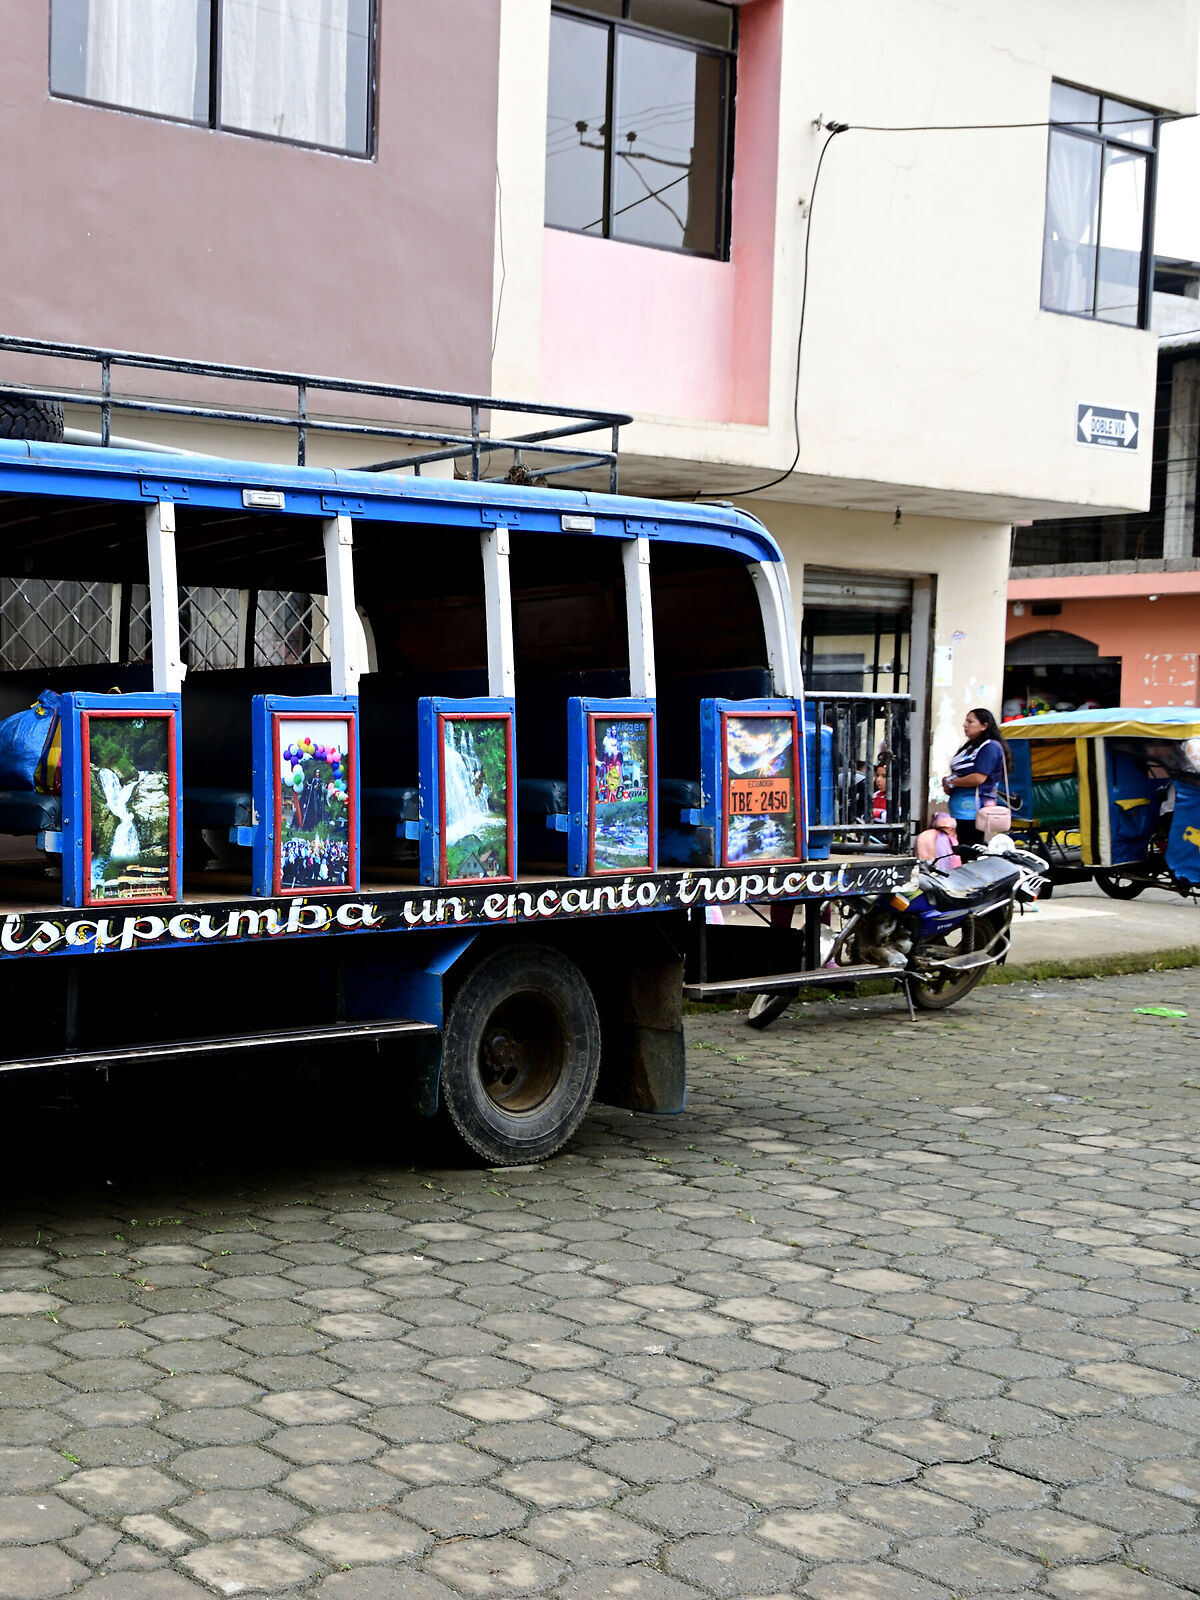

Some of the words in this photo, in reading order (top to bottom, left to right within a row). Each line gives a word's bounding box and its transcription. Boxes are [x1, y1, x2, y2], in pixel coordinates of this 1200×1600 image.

[1091, 418, 1112, 435] DOBLE
[748, 779, 774, 788] ECUADOR
[400, 896, 470, 925] un
[478, 876, 660, 919] encanto
[676, 863, 855, 905] tropical
